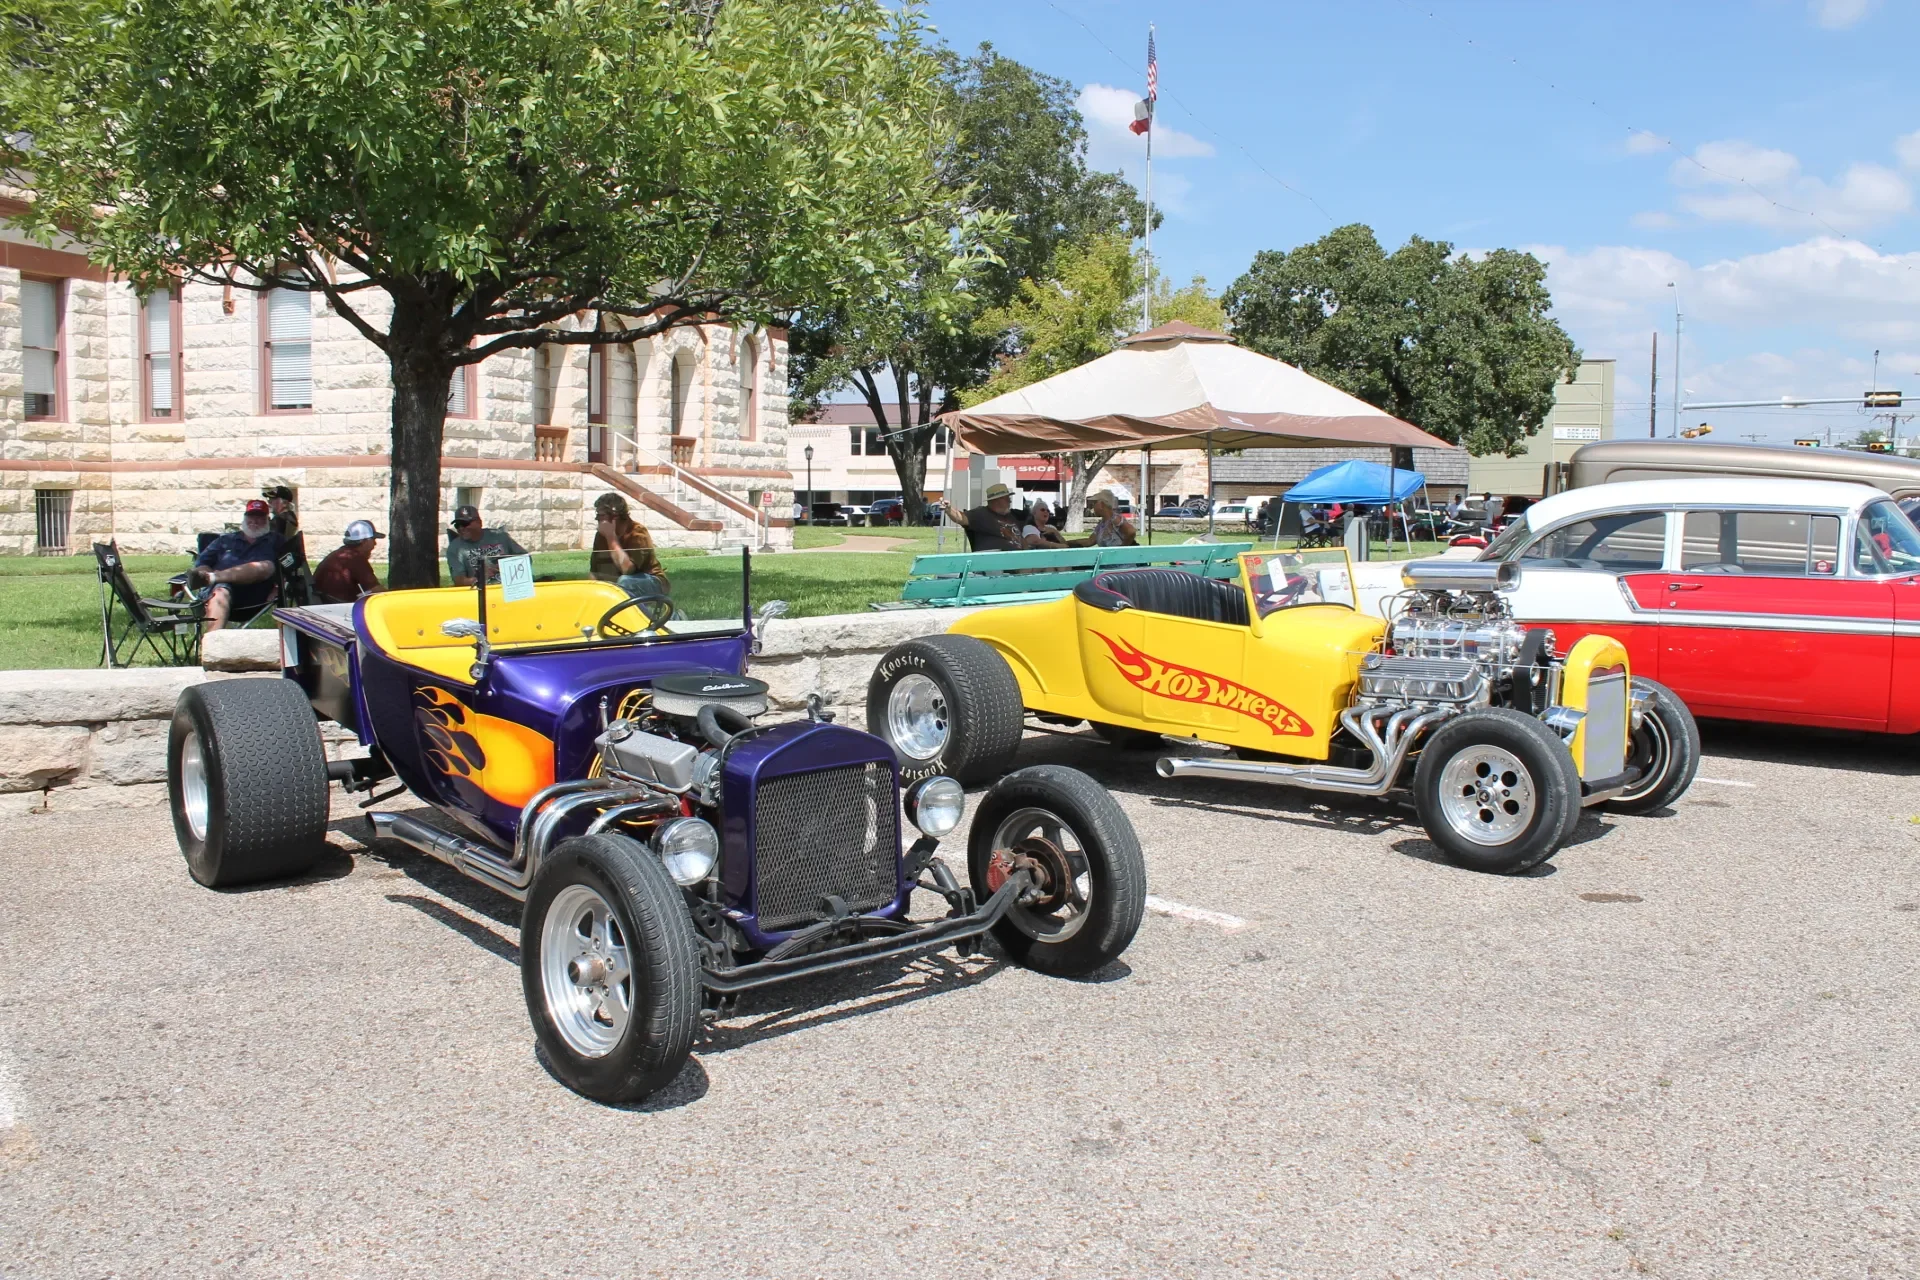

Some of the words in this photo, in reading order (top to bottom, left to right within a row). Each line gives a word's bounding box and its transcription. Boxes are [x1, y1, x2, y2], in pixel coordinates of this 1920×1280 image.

[1018, 465, 1056, 473] SHOP
[880, 651, 926, 682] Hoosier
[899, 754, 948, 780] Hoosier
